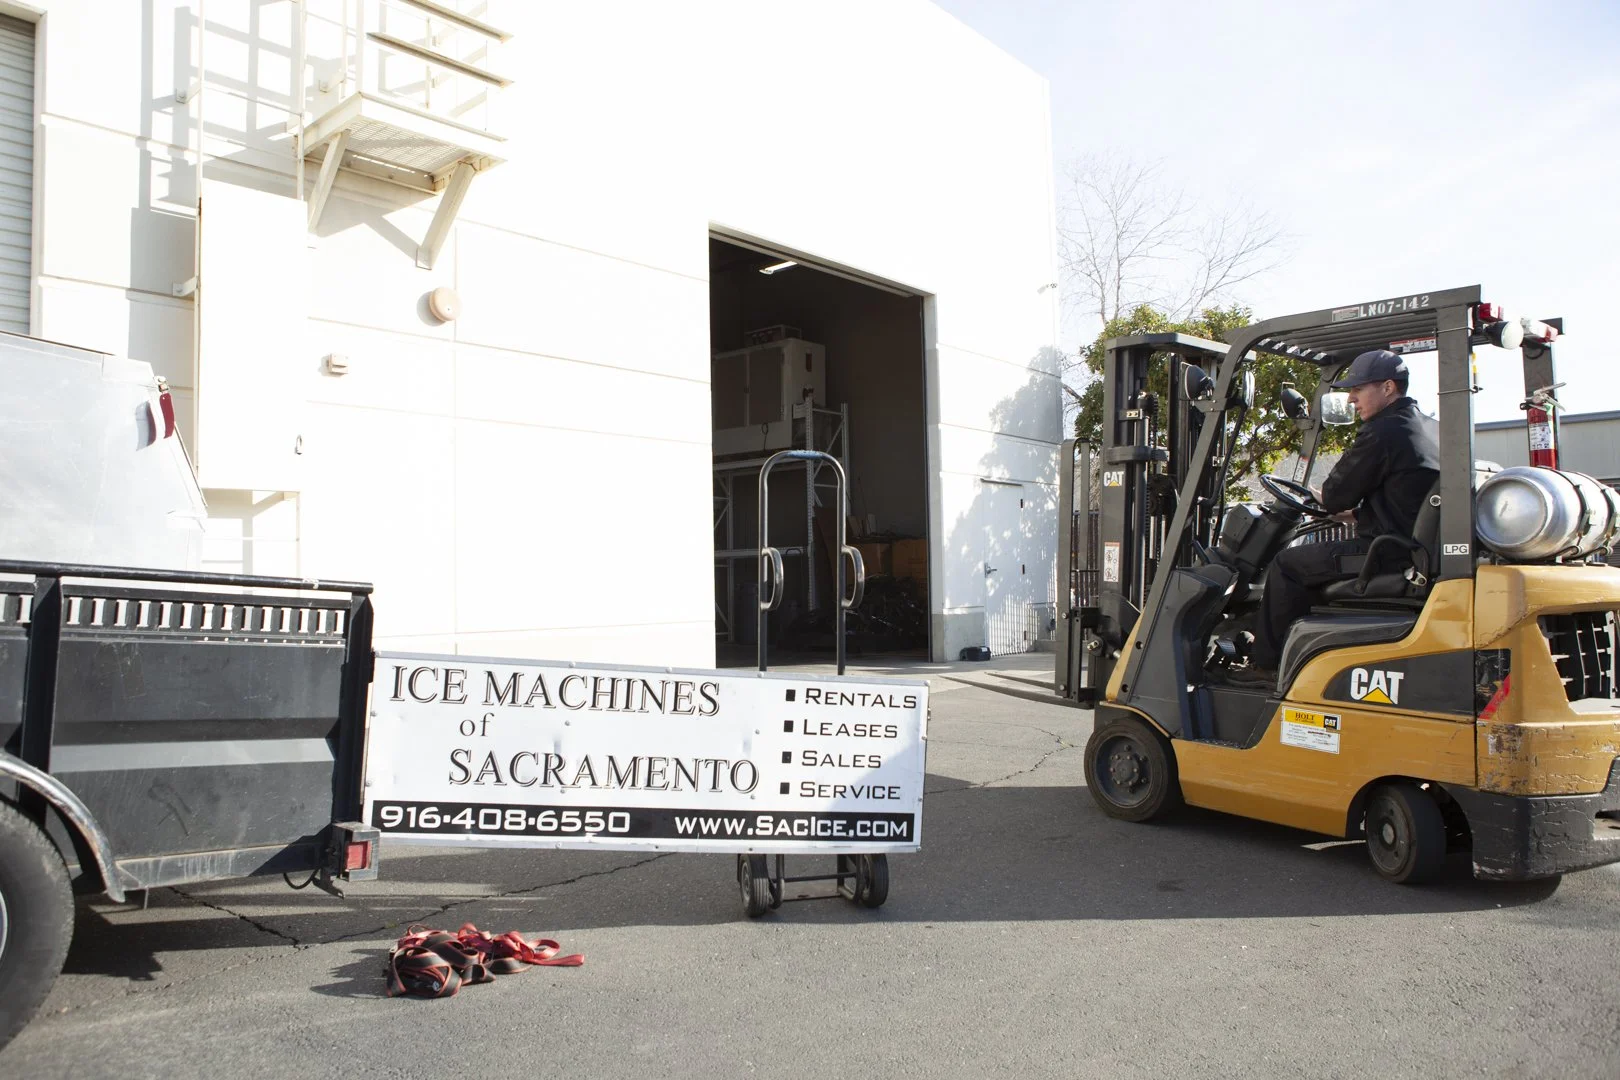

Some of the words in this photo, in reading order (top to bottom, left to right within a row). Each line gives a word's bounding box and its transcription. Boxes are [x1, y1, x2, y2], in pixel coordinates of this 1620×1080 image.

[1103, 471, 1125, 487] CAT
[1445, 545, 1468, 554] LPG
[389, 665, 468, 704] ICE
[482, 670, 721, 716] MACHINES
[1350, 667, 1405, 705] CAT
[805, 687, 917, 709] RENTALS
[459, 712, 495, 737] of
[1295, 712, 1315, 721] HOLT
[1324, 718, 1337, 727] CAT
[803, 719, 898, 739] LEASES
[802, 750, 881, 769] SALES
[449, 748, 760, 794] SACRAMENTO
[800, 781, 901, 800] SERVICE
